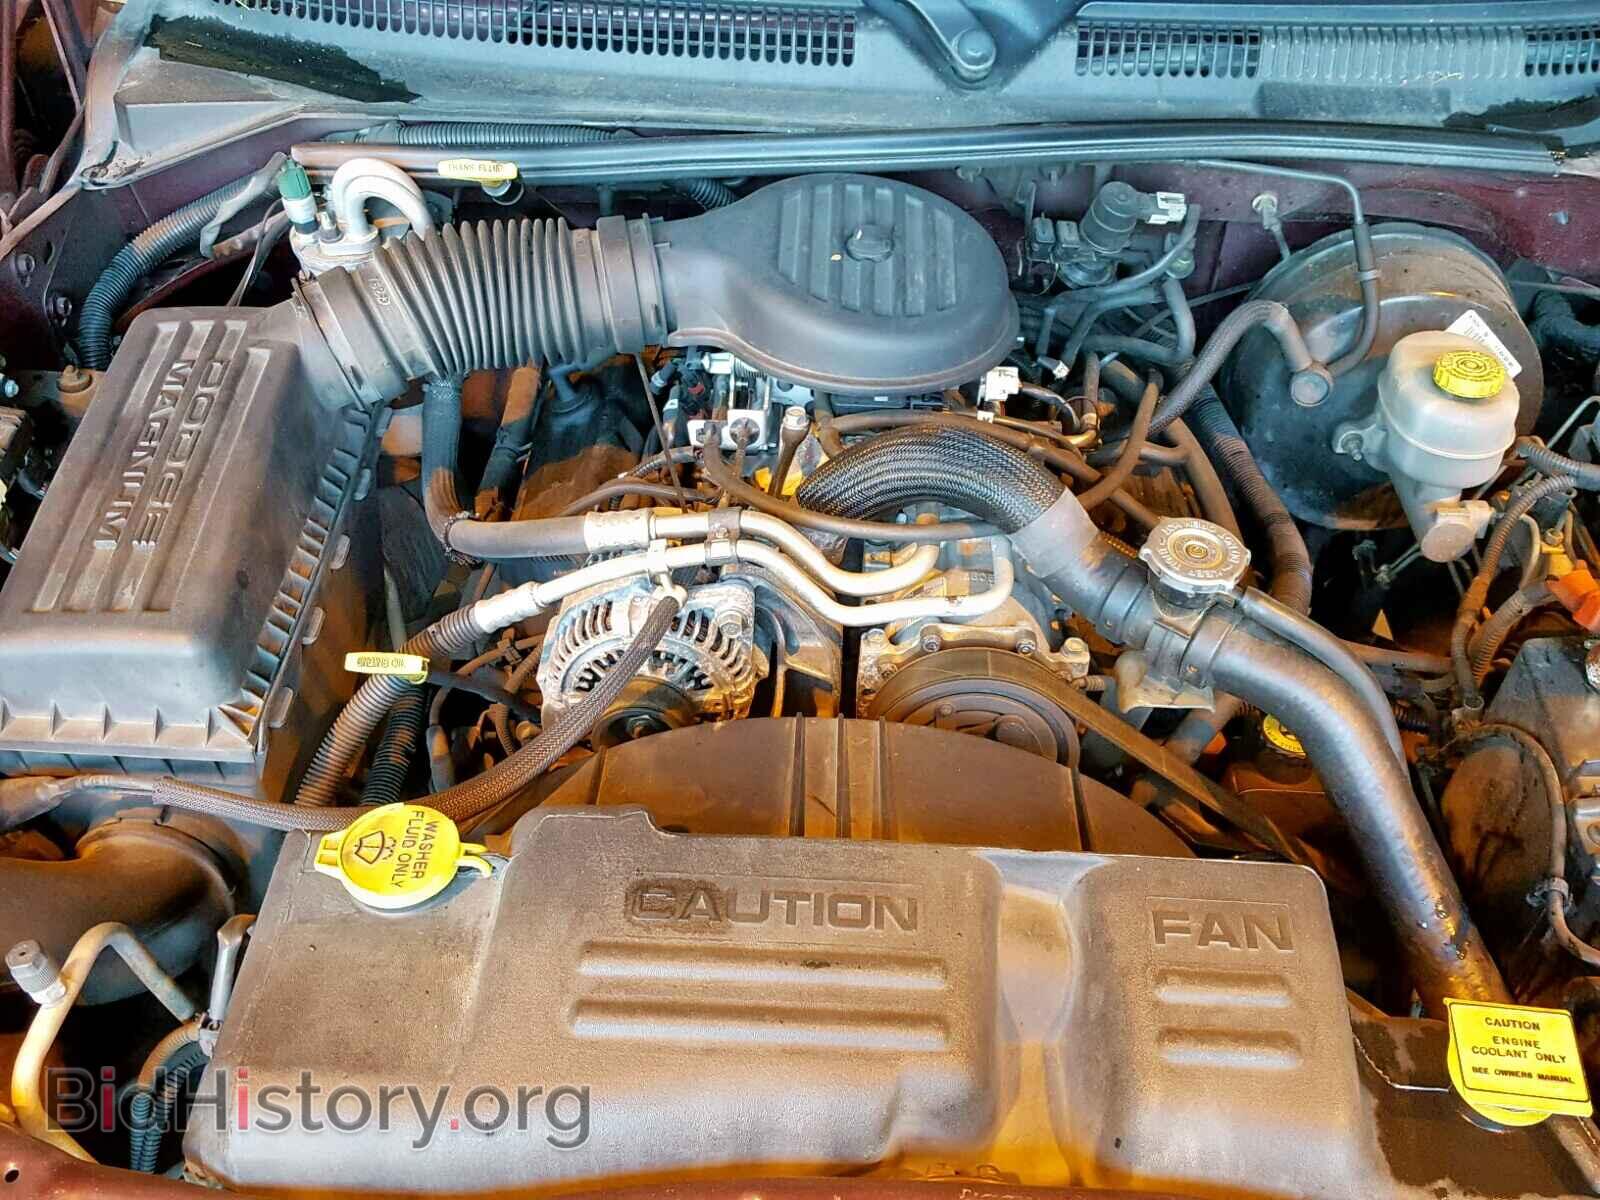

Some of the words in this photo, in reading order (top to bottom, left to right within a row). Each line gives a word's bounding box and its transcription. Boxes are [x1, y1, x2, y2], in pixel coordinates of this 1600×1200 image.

[94, 360, 197, 550] MAGNUM
[131, 360, 231, 550] DODGE
[401, 810, 425, 849] FLUID
[412, 819, 440, 880] WASHER
[391, 852, 412, 888] ONLY
[626, 880, 918, 931] CAUTION
[1151, 910, 1295, 952] FAN
[1484, 1016, 1541, 1031] CAUTION
[1471, 1045, 1528, 1059] COOLANT
[1535, 1052, 1567, 1064] ONLY
[1492, 1036, 1541, 1049] ENGINE
[1471, 1066, 1489, 1075] SEE
[1494, 1068, 1533, 1079] OWNERS
[1537, 1072, 1576, 1084] MANUAL
